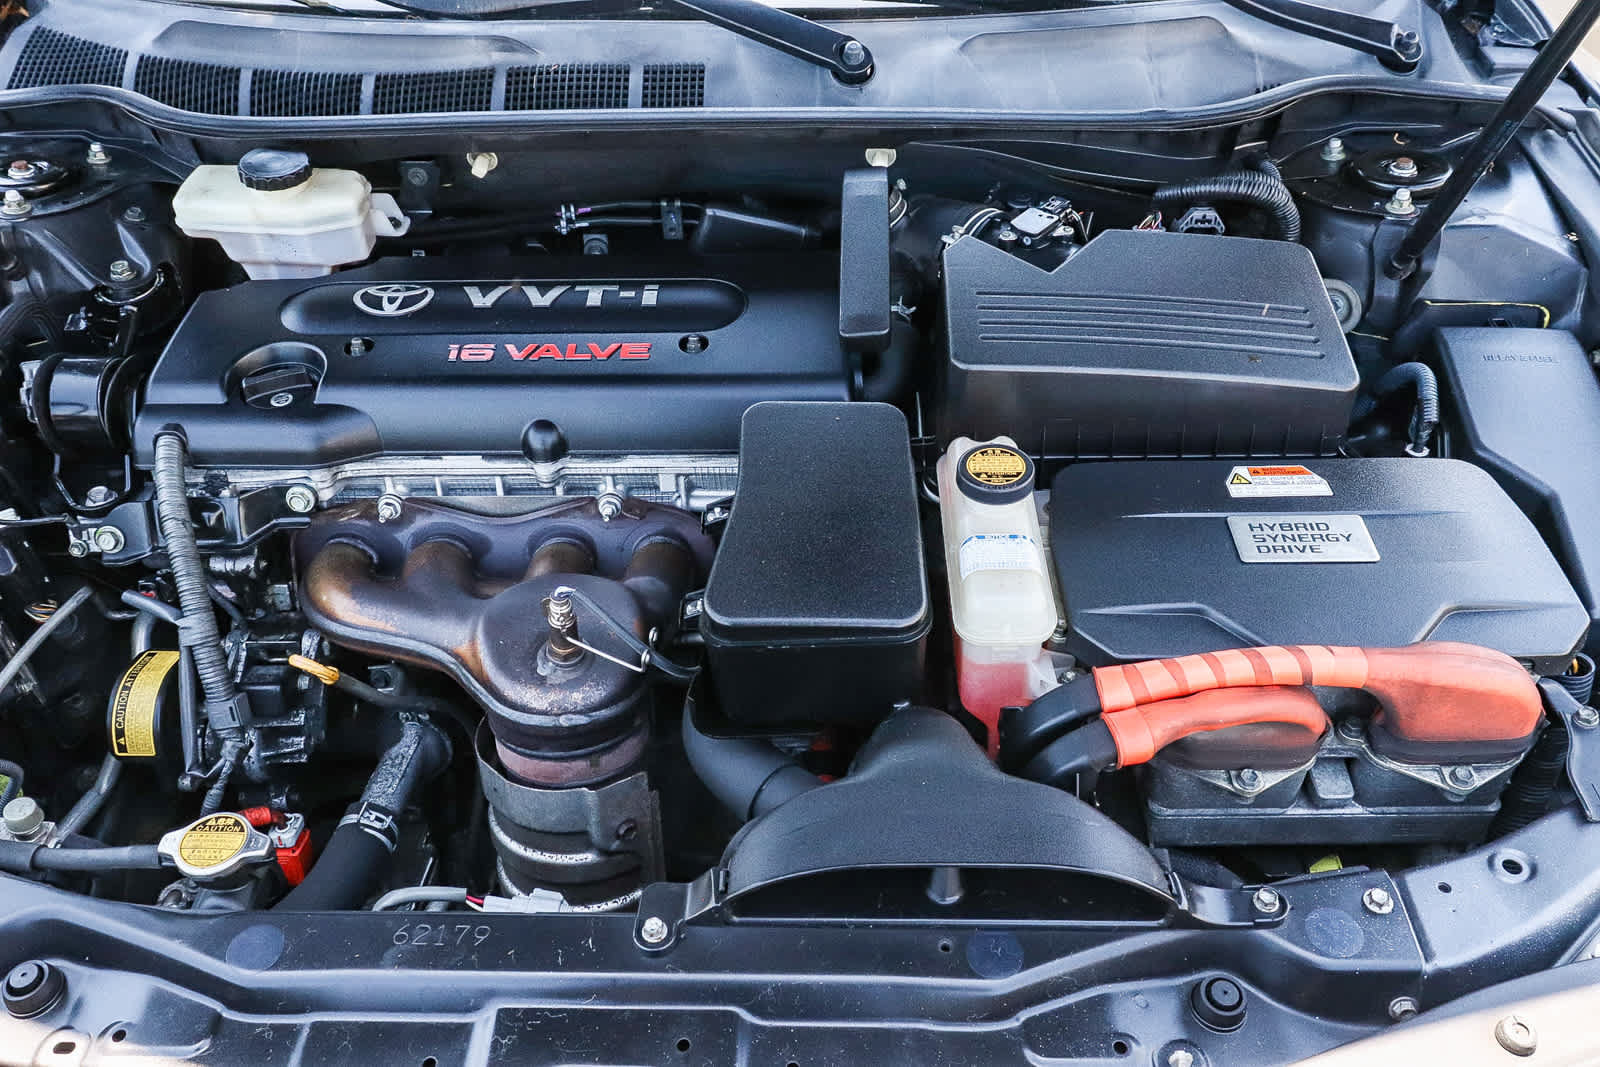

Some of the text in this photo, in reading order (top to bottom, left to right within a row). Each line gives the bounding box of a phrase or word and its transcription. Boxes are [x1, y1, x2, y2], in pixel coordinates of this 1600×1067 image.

[463, 285, 659, 308] VVT-i
[448, 343, 652, 361] 16 VALVE
[1248, 522, 1330, 532] HYBRID
[1252, 533, 1352, 543] SYNERGY
[1256, 545, 1323, 554] DRIVE
[115, 690, 128, 729] CAUTION
[125, 655, 153, 687] ATTENTION
[393, 922, 491, 946] 62179
